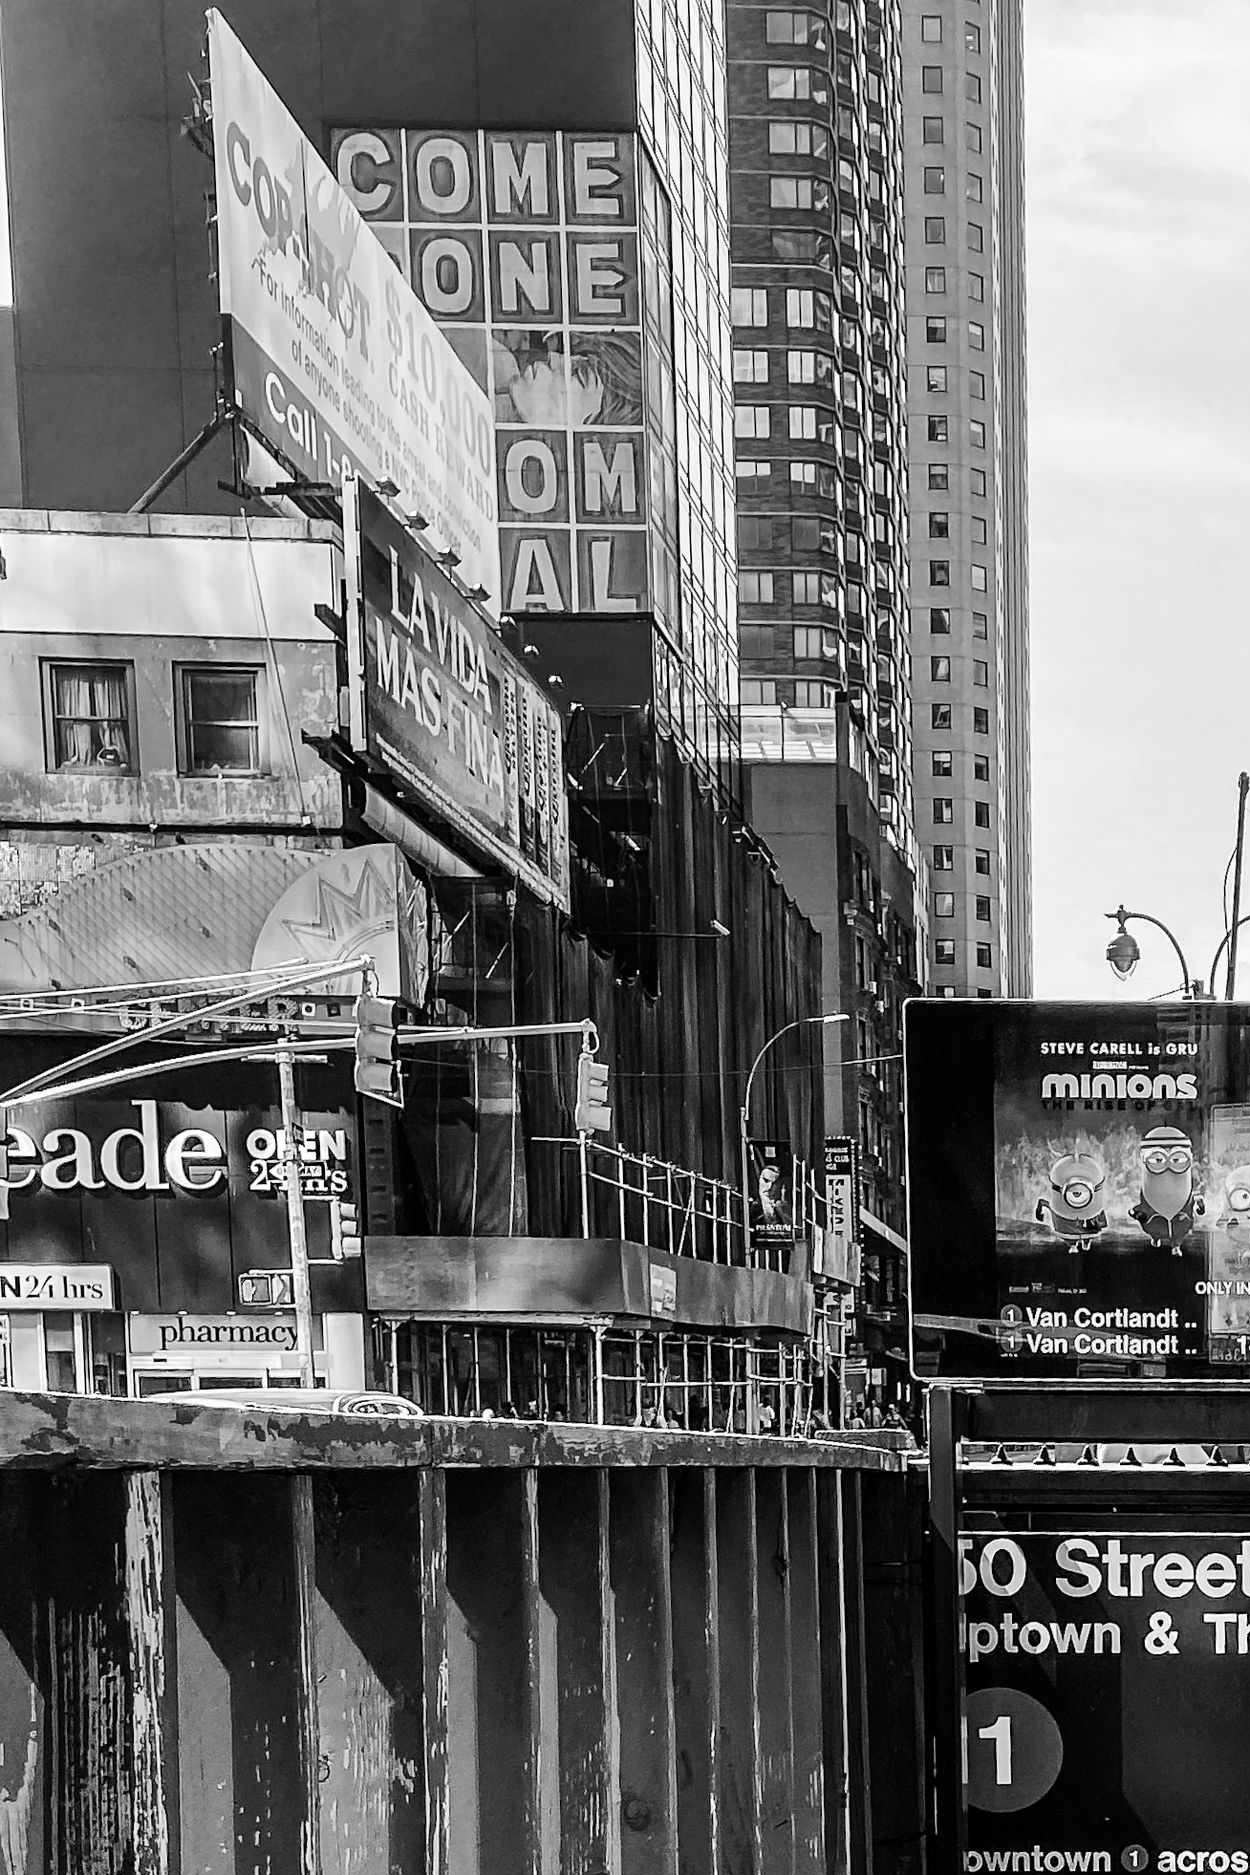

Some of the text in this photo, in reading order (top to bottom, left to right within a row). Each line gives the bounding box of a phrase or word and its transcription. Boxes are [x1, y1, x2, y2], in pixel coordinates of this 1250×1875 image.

[337, 132, 620, 215] COME
[265, 372, 318, 461] Call
[388, 357, 429, 442] CASH
[1041, 1043, 1198, 1056] STEVE CARELL is GRU
[25, 1275, 53, 1298] 24
[62, 1275, 103, 1299] hrs
[1195, 1282, 1232, 1295] ONLY
[1236, 1282, 1250, 1295] IN
[159, 1316, 299, 1351] pharmacy
[1026, 1307, 1067, 1328] Van
[1074, 1307, 1179, 1328] Cortlandt
[1026, 1334, 1067, 1354] Van
[1074, 1334, 1179, 1354] Cortlandt
[959, 1613, 1121, 1663] ptown
[1144, 1611, 1180, 1655] &
[979, 1716, 1012, 1785] 1
